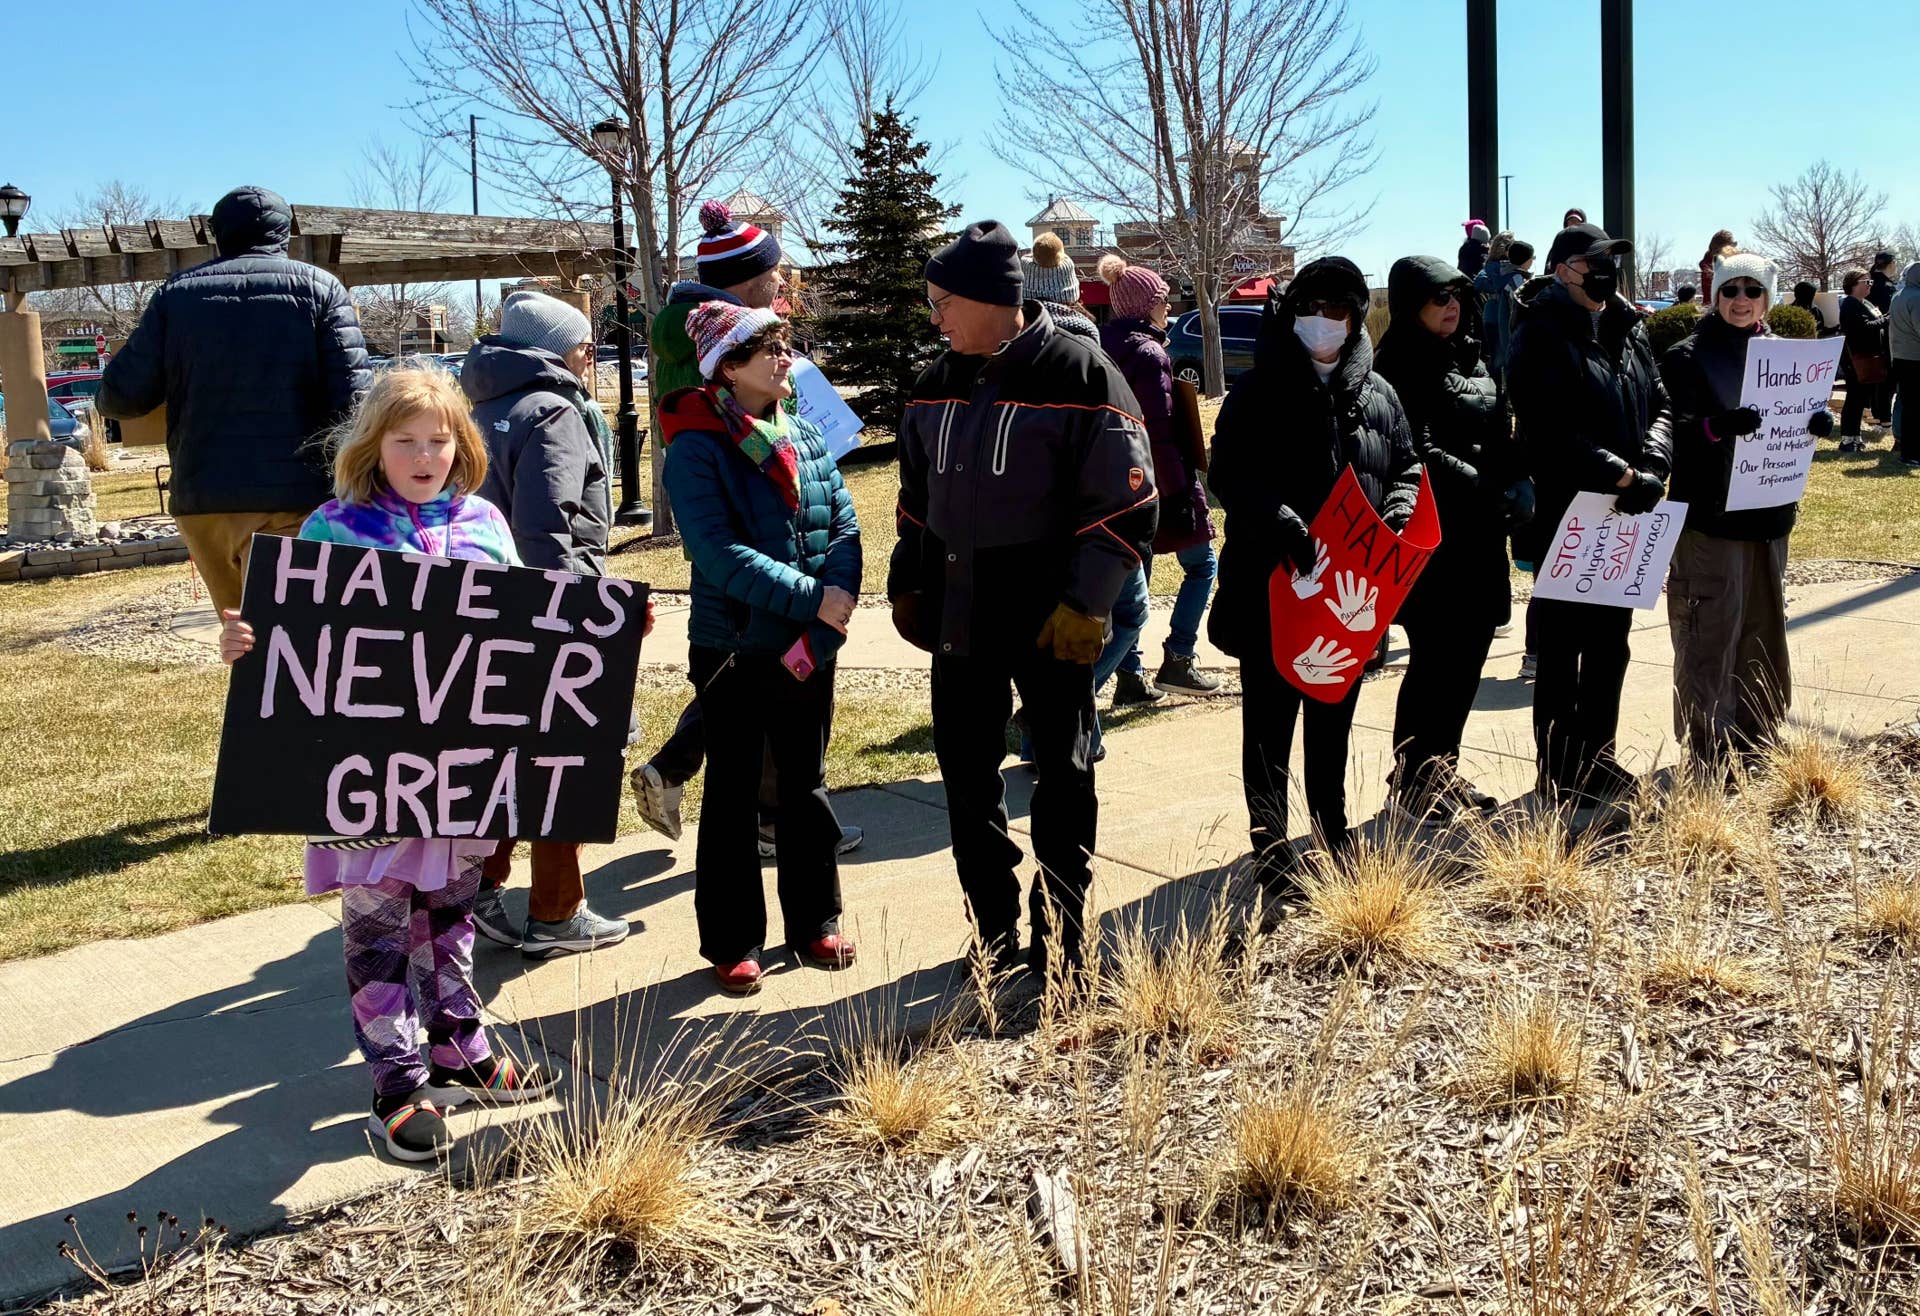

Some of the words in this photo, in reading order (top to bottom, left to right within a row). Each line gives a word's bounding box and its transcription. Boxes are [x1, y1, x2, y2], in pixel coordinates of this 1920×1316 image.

[67, 323, 103, 335] nails
[1757, 358, 1802, 388] Hands
[1806, 359, 1834, 383] OFF
[1773, 398, 1806, 416] Social
[1766, 439, 1782, 451] and
[1770, 425, 1809, 439] Medicar
[1740, 459, 1759, 474] Our
[1762, 457, 1797, 470] Personal
[1758, 472, 1804, 488] Information
[1550, 516, 1586, 579] STOP
[1575, 507, 1622, 594] Oligarchy
[1602, 521, 1637, 581] SAVE
[1624, 512, 1670, 596] Democracy
[274, 537, 510, 619] HATE
[531, 569, 635, 639] IS
[260, 624, 603, 733] NEVER
[326, 747, 586, 839] GREAT
